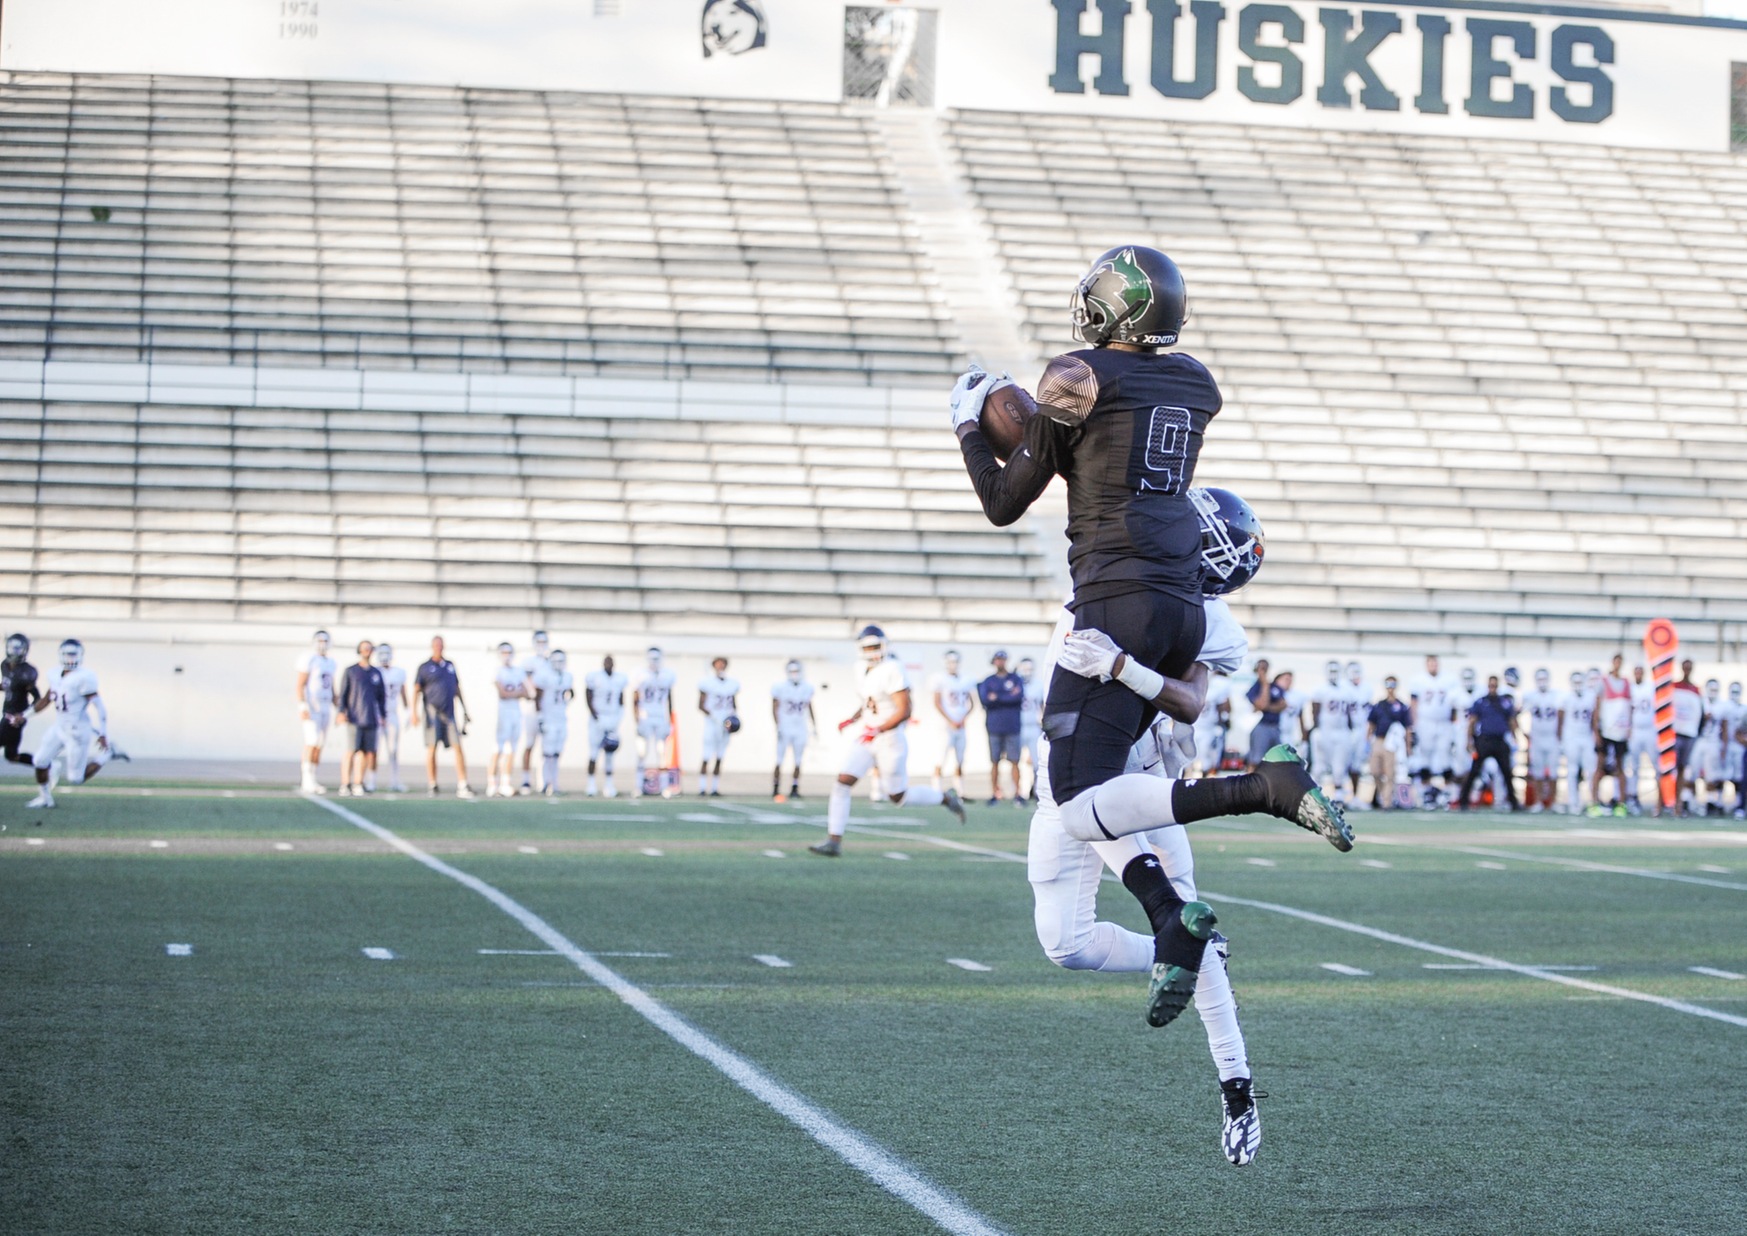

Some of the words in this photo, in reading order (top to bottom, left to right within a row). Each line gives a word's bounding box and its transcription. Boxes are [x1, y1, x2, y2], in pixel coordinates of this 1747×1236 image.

[1048, 0, 1615, 124] HUSKIES
[1142, 334, 1177, 344] XENITH
[1137, 405, 1192, 497] 9
